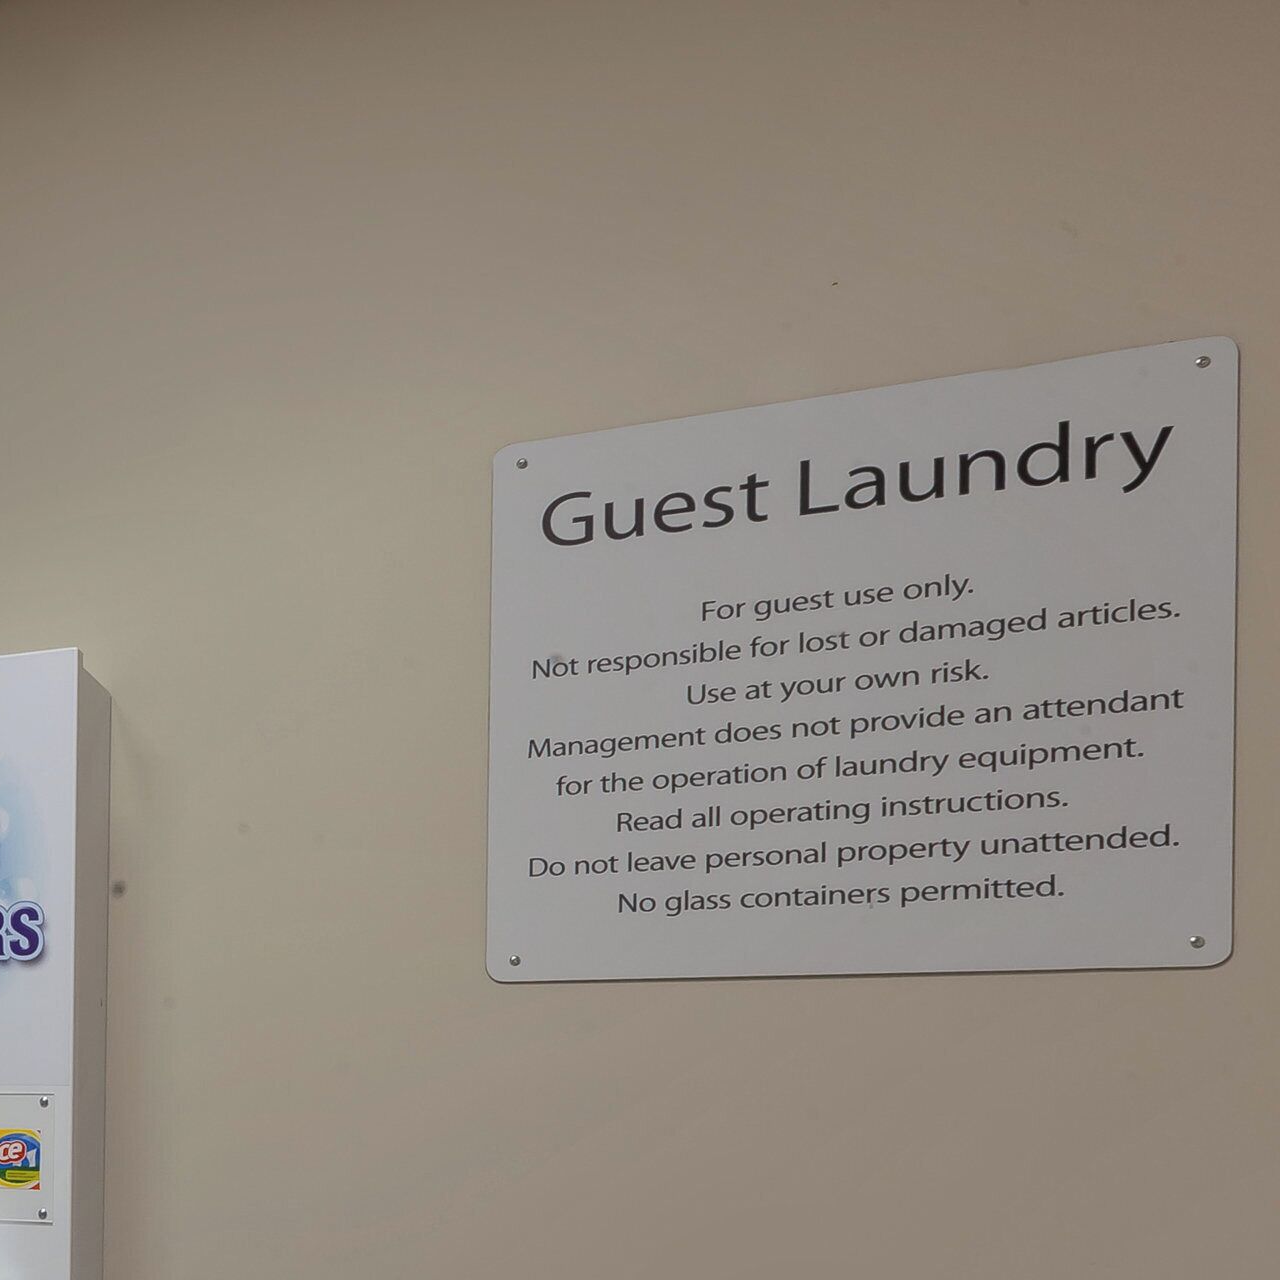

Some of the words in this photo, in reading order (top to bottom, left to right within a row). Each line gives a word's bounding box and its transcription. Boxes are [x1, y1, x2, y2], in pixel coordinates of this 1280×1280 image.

[541, 472, 770, 547] Guest
[798, 419, 1175, 517] Laundry
[701, 600, 747, 622] For
[753, 589, 835, 622] guest
[843, 586, 895, 607] use
[902, 573, 974, 602] only.
[531, 654, 580, 680] Not
[587, 639, 742, 677] responsible
[748, 635, 791, 659] for
[798, 630, 851, 654] lost
[858, 628, 892, 648] or
[898, 607, 1047, 644] damaged
[1057, 598, 1181, 629] articles.
[686, 683, 737, 706] Use
[744, 680, 773, 701] at
[779, 675, 847, 704] your
[854, 669, 920, 691] own
[931, 658, 990, 685] risk.
[527, 727, 707, 760] Management
[713, 721, 782, 745] does
[791, 716, 842, 739] not
[850, 703, 966, 740] provide
[974, 705, 1013, 725] an
[1022, 688, 1185, 721] attendant
[555, 774, 594, 797] for
[599, 771, 645, 794] the
[651, 762, 787, 795] operation
[796, 755, 829, 780] of
[834, 749, 950, 778] laundry
[957, 737, 1145, 773] equipment.
[616, 807, 683, 833] Read
[691, 805, 721, 829] all
[729, 799, 871, 831] operating
[880, 788, 1069, 818] instructions.
[528, 857, 566, 878] Do
[574, 855, 620, 876] not
[626, 851, 697, 873] leave
[705, 840, 827, 875] personal
[837, 837, 972, 869] property
[980, 823, 1180, 856] unattended.
[618, 892, 657, 914] No
[664, 889, 732, 918] glass
[739, 884, 891, 910] containers
[900, 873, 1065, 909] permitted.
